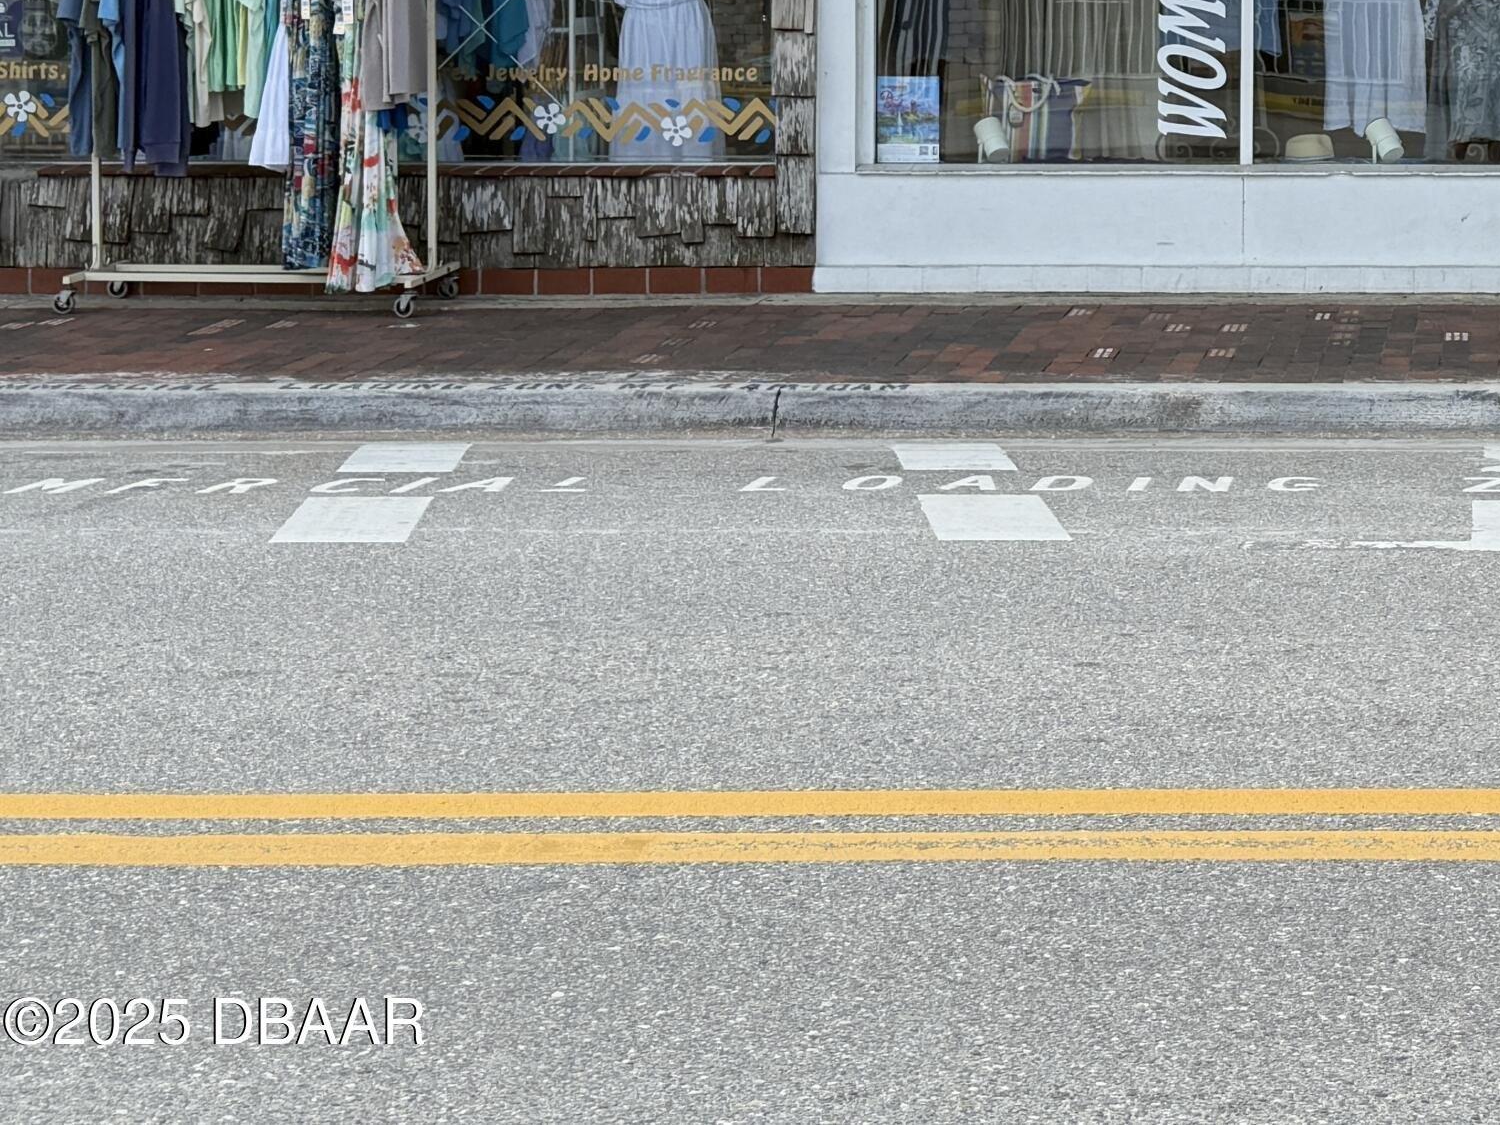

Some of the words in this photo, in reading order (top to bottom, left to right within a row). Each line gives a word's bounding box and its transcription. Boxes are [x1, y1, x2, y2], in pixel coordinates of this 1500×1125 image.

[583, 64, 644, 81] Home
[651, 64, 759, 84] Fragrance
[739, 475, 1321, 492] LOADING
